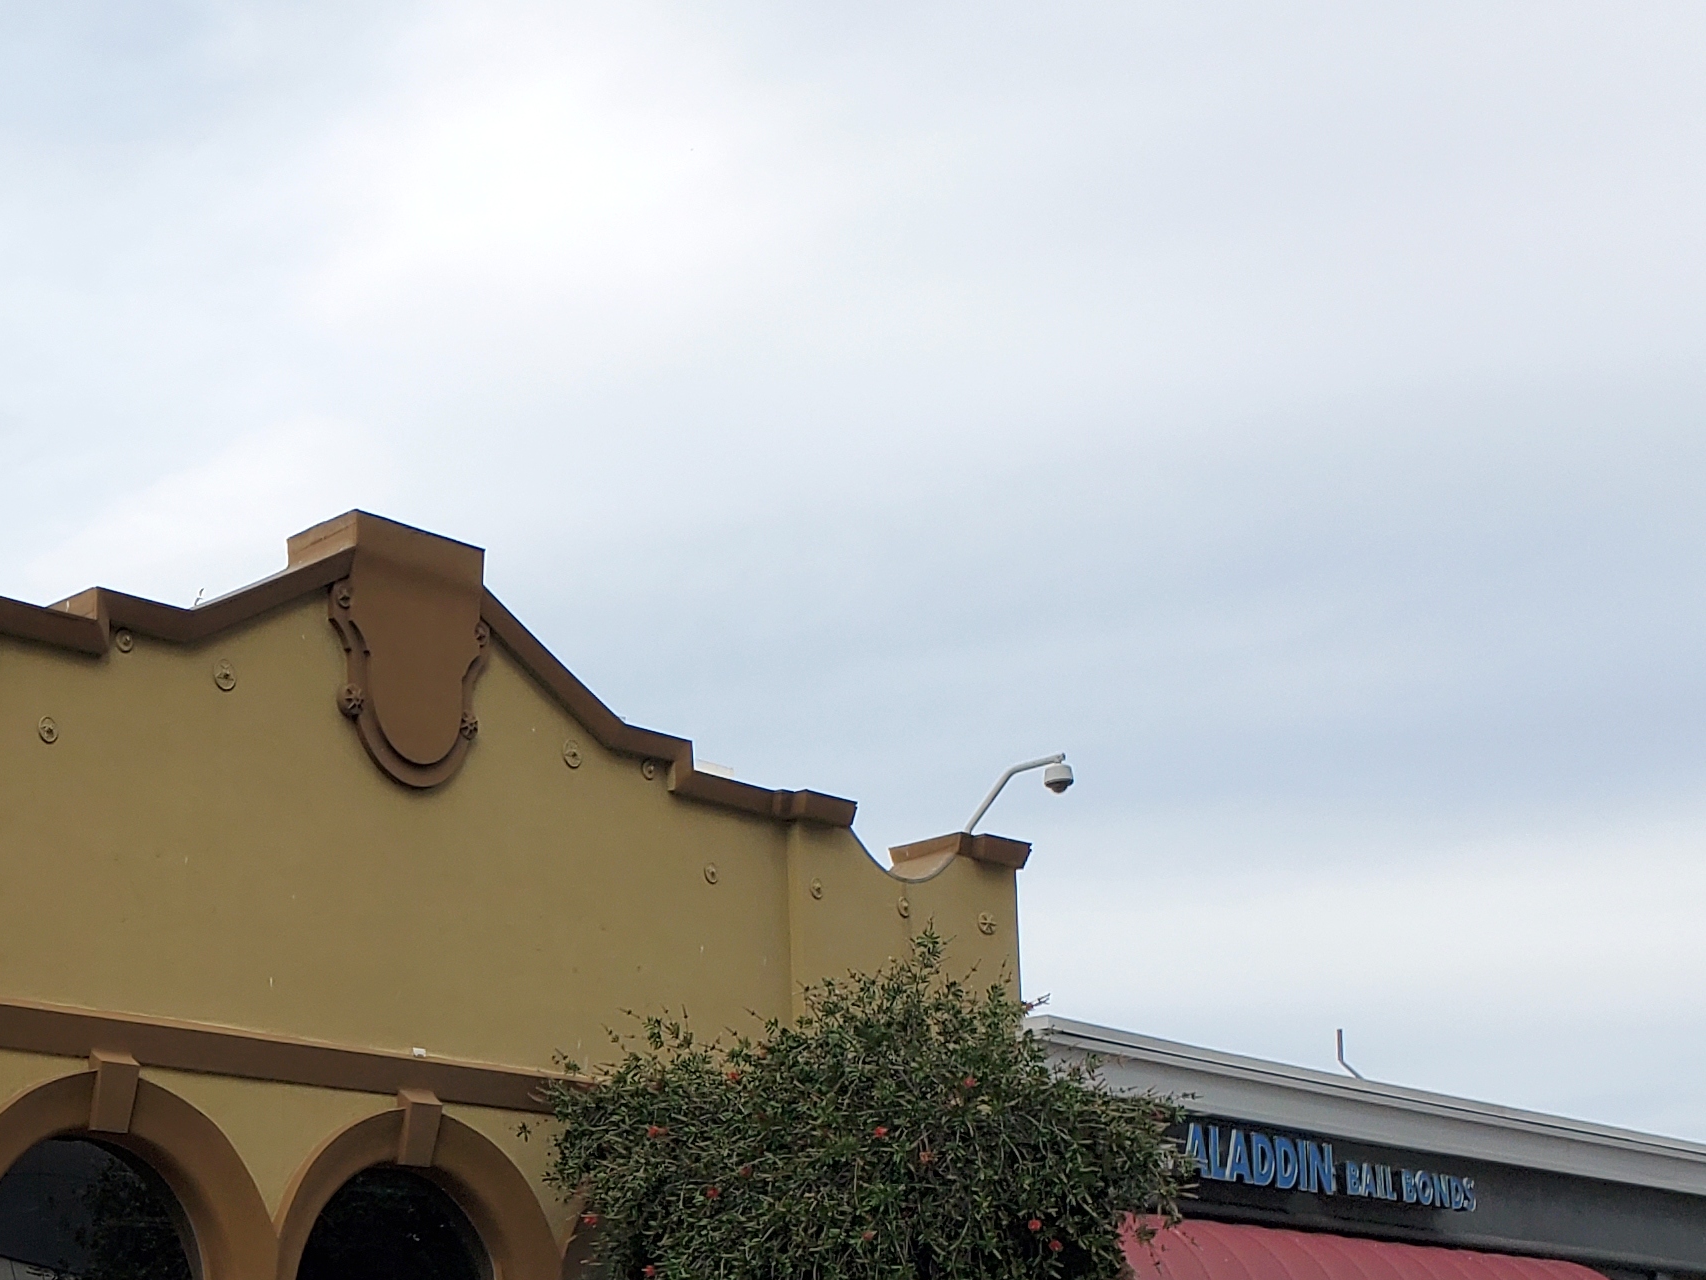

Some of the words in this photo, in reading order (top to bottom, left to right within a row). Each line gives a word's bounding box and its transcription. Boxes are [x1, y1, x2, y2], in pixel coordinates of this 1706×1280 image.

[1185, 1121, 1335, 1196] ALADDIN
[1345, 1160, 1397, 1201] BAIL
[1402, 1168, 1478, 1213] BONDS
